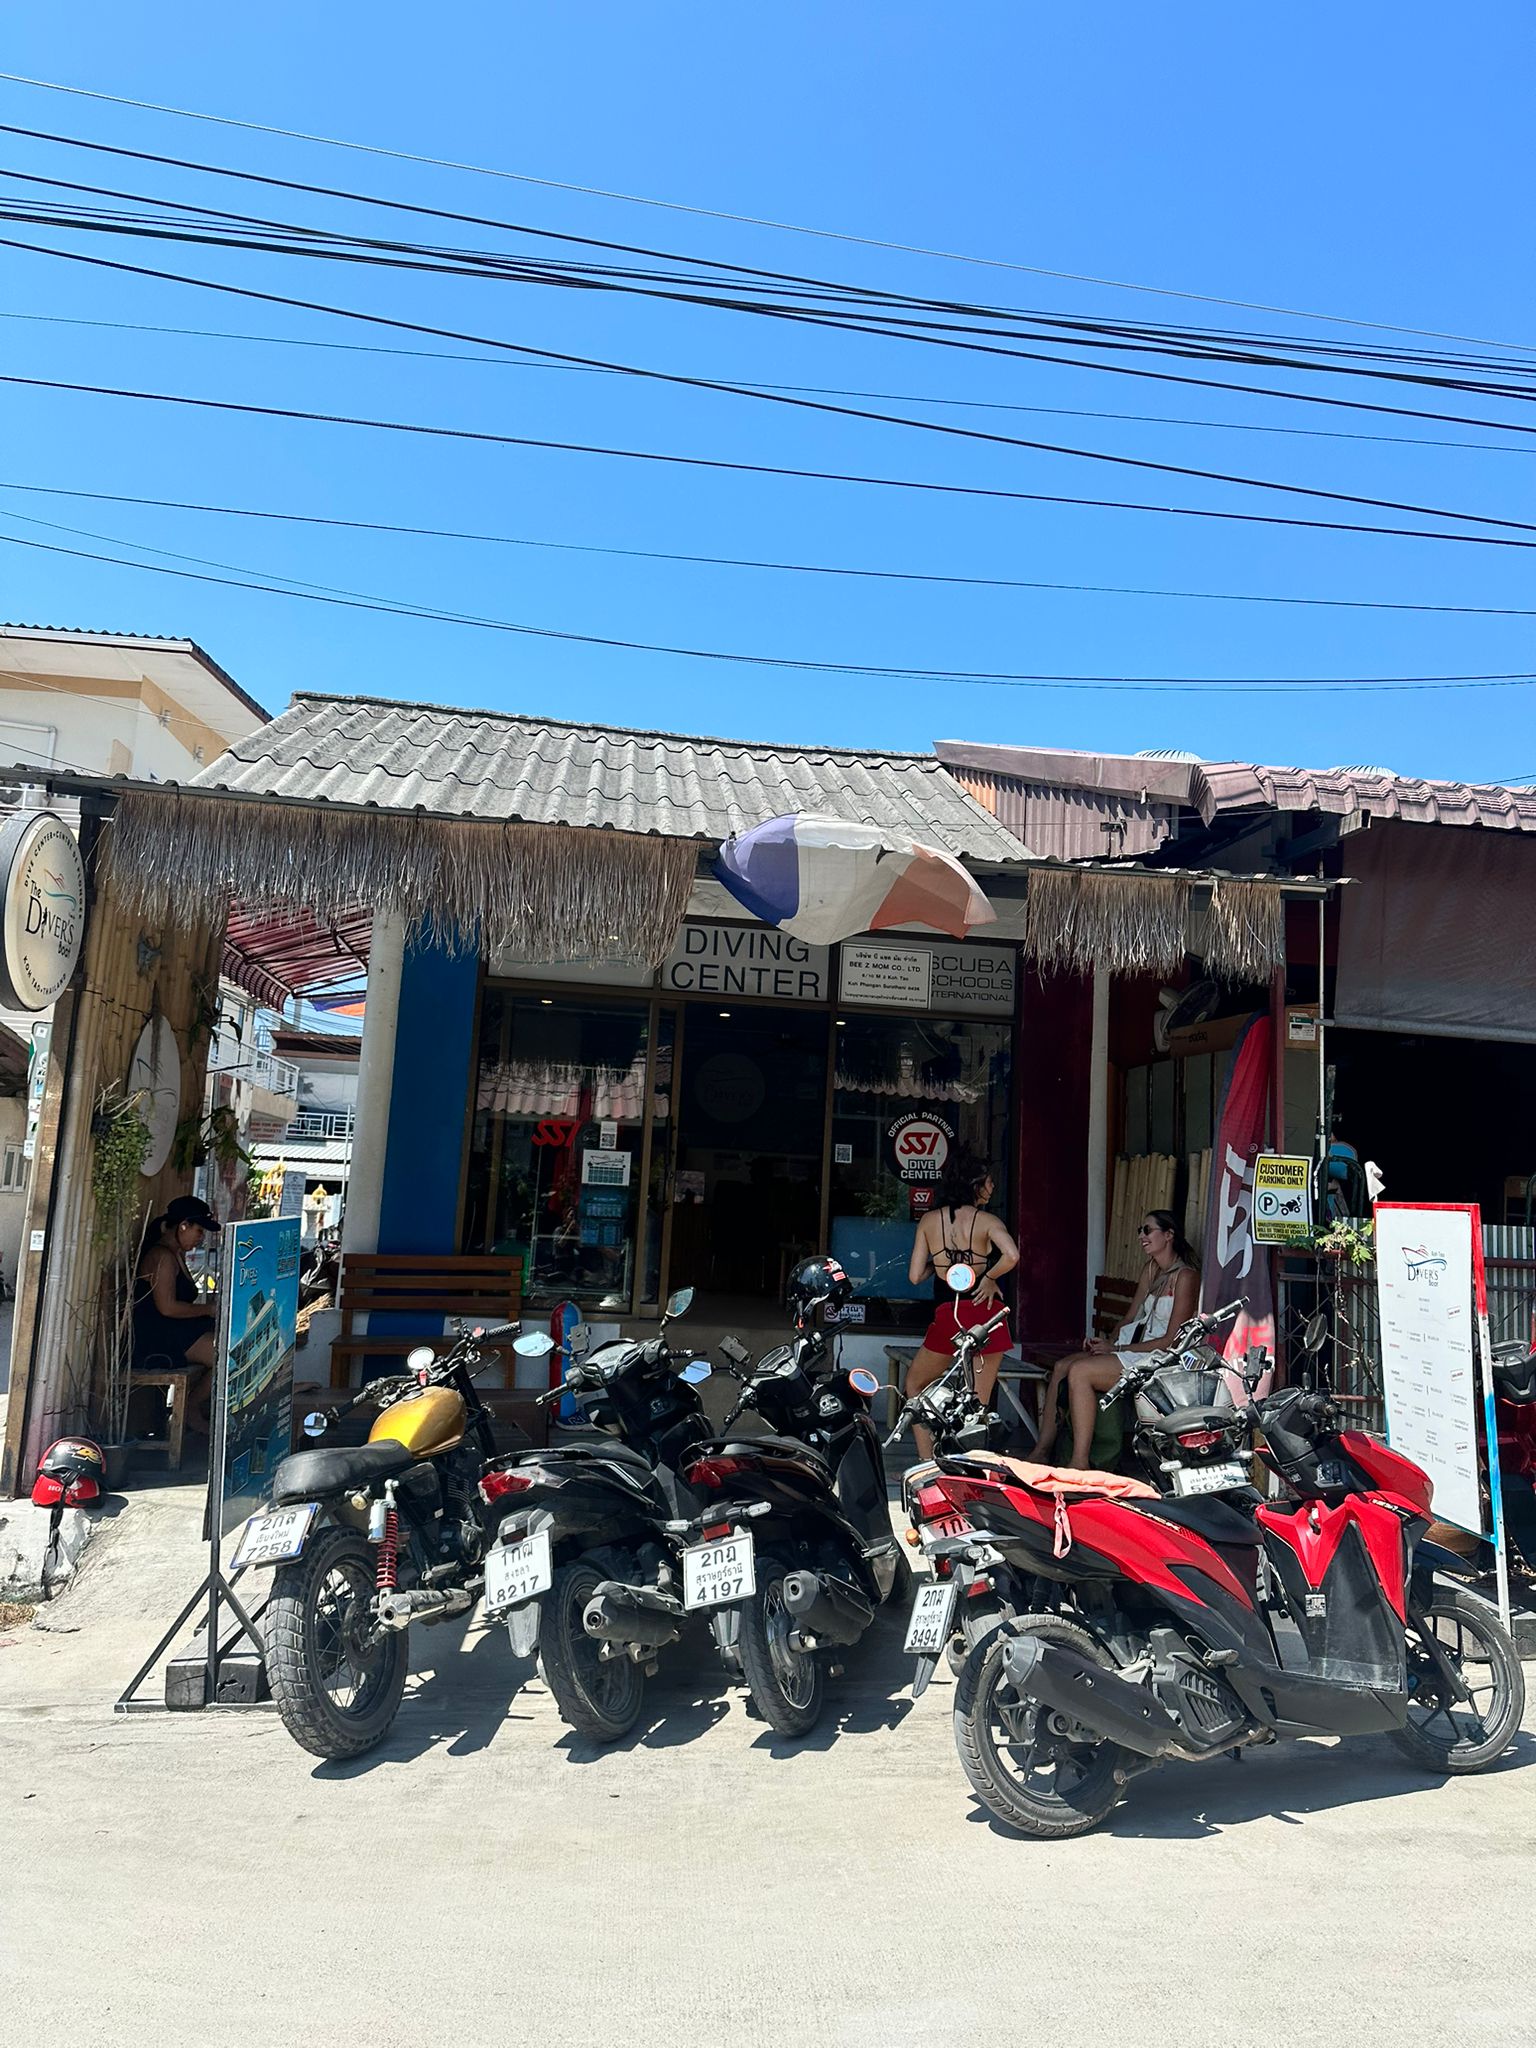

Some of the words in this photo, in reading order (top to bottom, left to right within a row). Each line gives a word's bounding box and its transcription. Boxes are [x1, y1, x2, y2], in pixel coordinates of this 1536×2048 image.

[24, 860, 34, 886] DIVE
[34, 831, 53, 856] CENTER
[30, 879, 42, 899] The
[685, 928, 809, 962] DIVING
[23, 954, 32, 978] KOH
[32, 978, 40, 992] TAO
[42, 973, 66, 995] THAILAND
[671, 961, 820, 998] CENTER
[932, 990, 1011, 1002] TERNATIONAL
[531, 1119, 581, 1148] SSI
[888, 1112, 918, 1138] OFFICIAL
[921, 1112, 955, 1138] PARTNER
[899, 1132, 940, 1156] SSI
[900, 1170, 942, 1180] CENTER
[909, 1160, 935, 1170] DIVE
[1260, 1164, 1304, 1177] CUSTOMER
[1259, 1175, 1286, 1184] PARKING
[1287, 1177, 1304, 1186] ONLY
[48, 1485, 78, 1497] HODA
[246, 1540, 292, 1560] 7258
[497, 1575, 539, 1603] 8217
[697, 1578, 743, 1601] 4197
[911, 1628, 938, 1646] 3494
